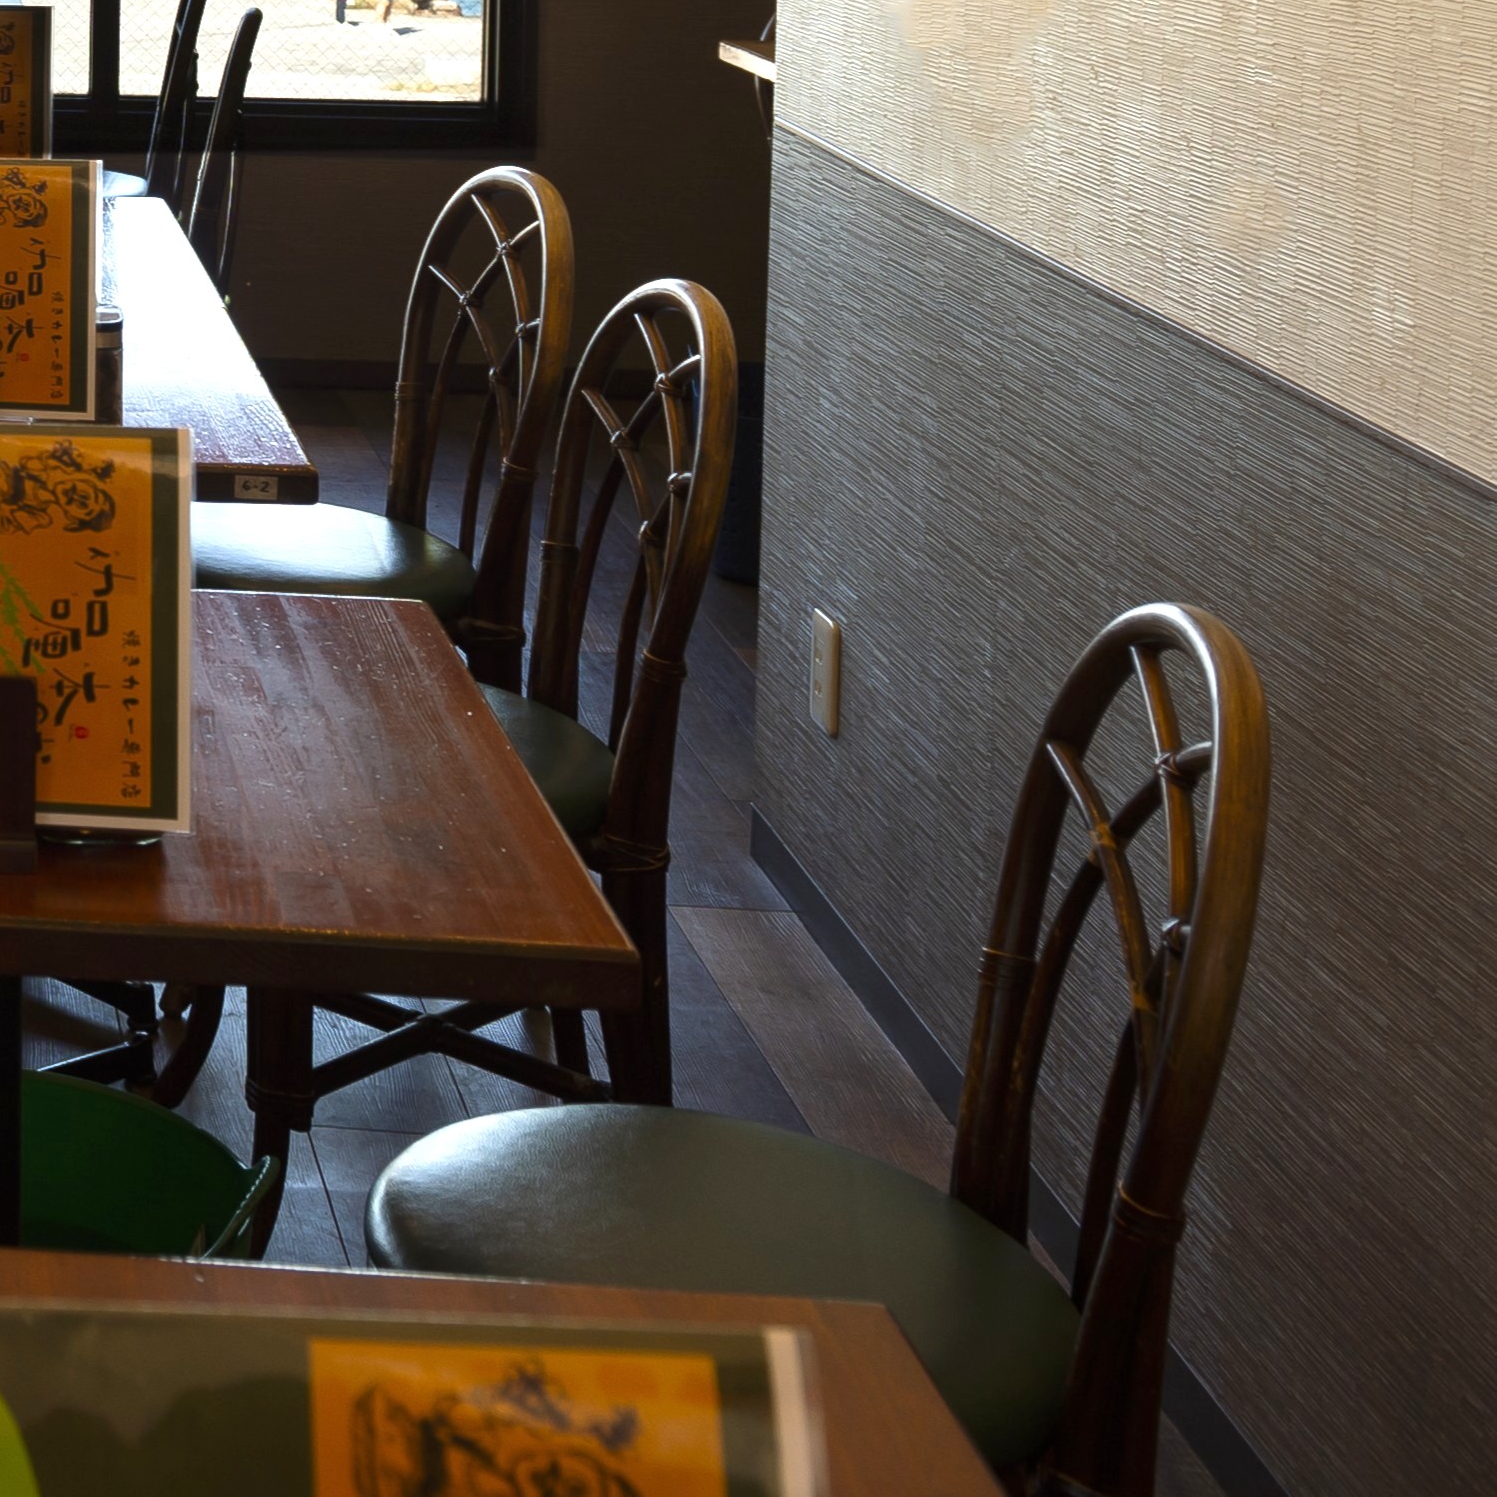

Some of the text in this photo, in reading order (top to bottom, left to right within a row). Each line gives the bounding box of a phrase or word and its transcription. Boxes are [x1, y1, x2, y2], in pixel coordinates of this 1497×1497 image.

[242, 480, 271, 493] 6-2
[120, 629, 143, 801] 焼きカレー専門店
